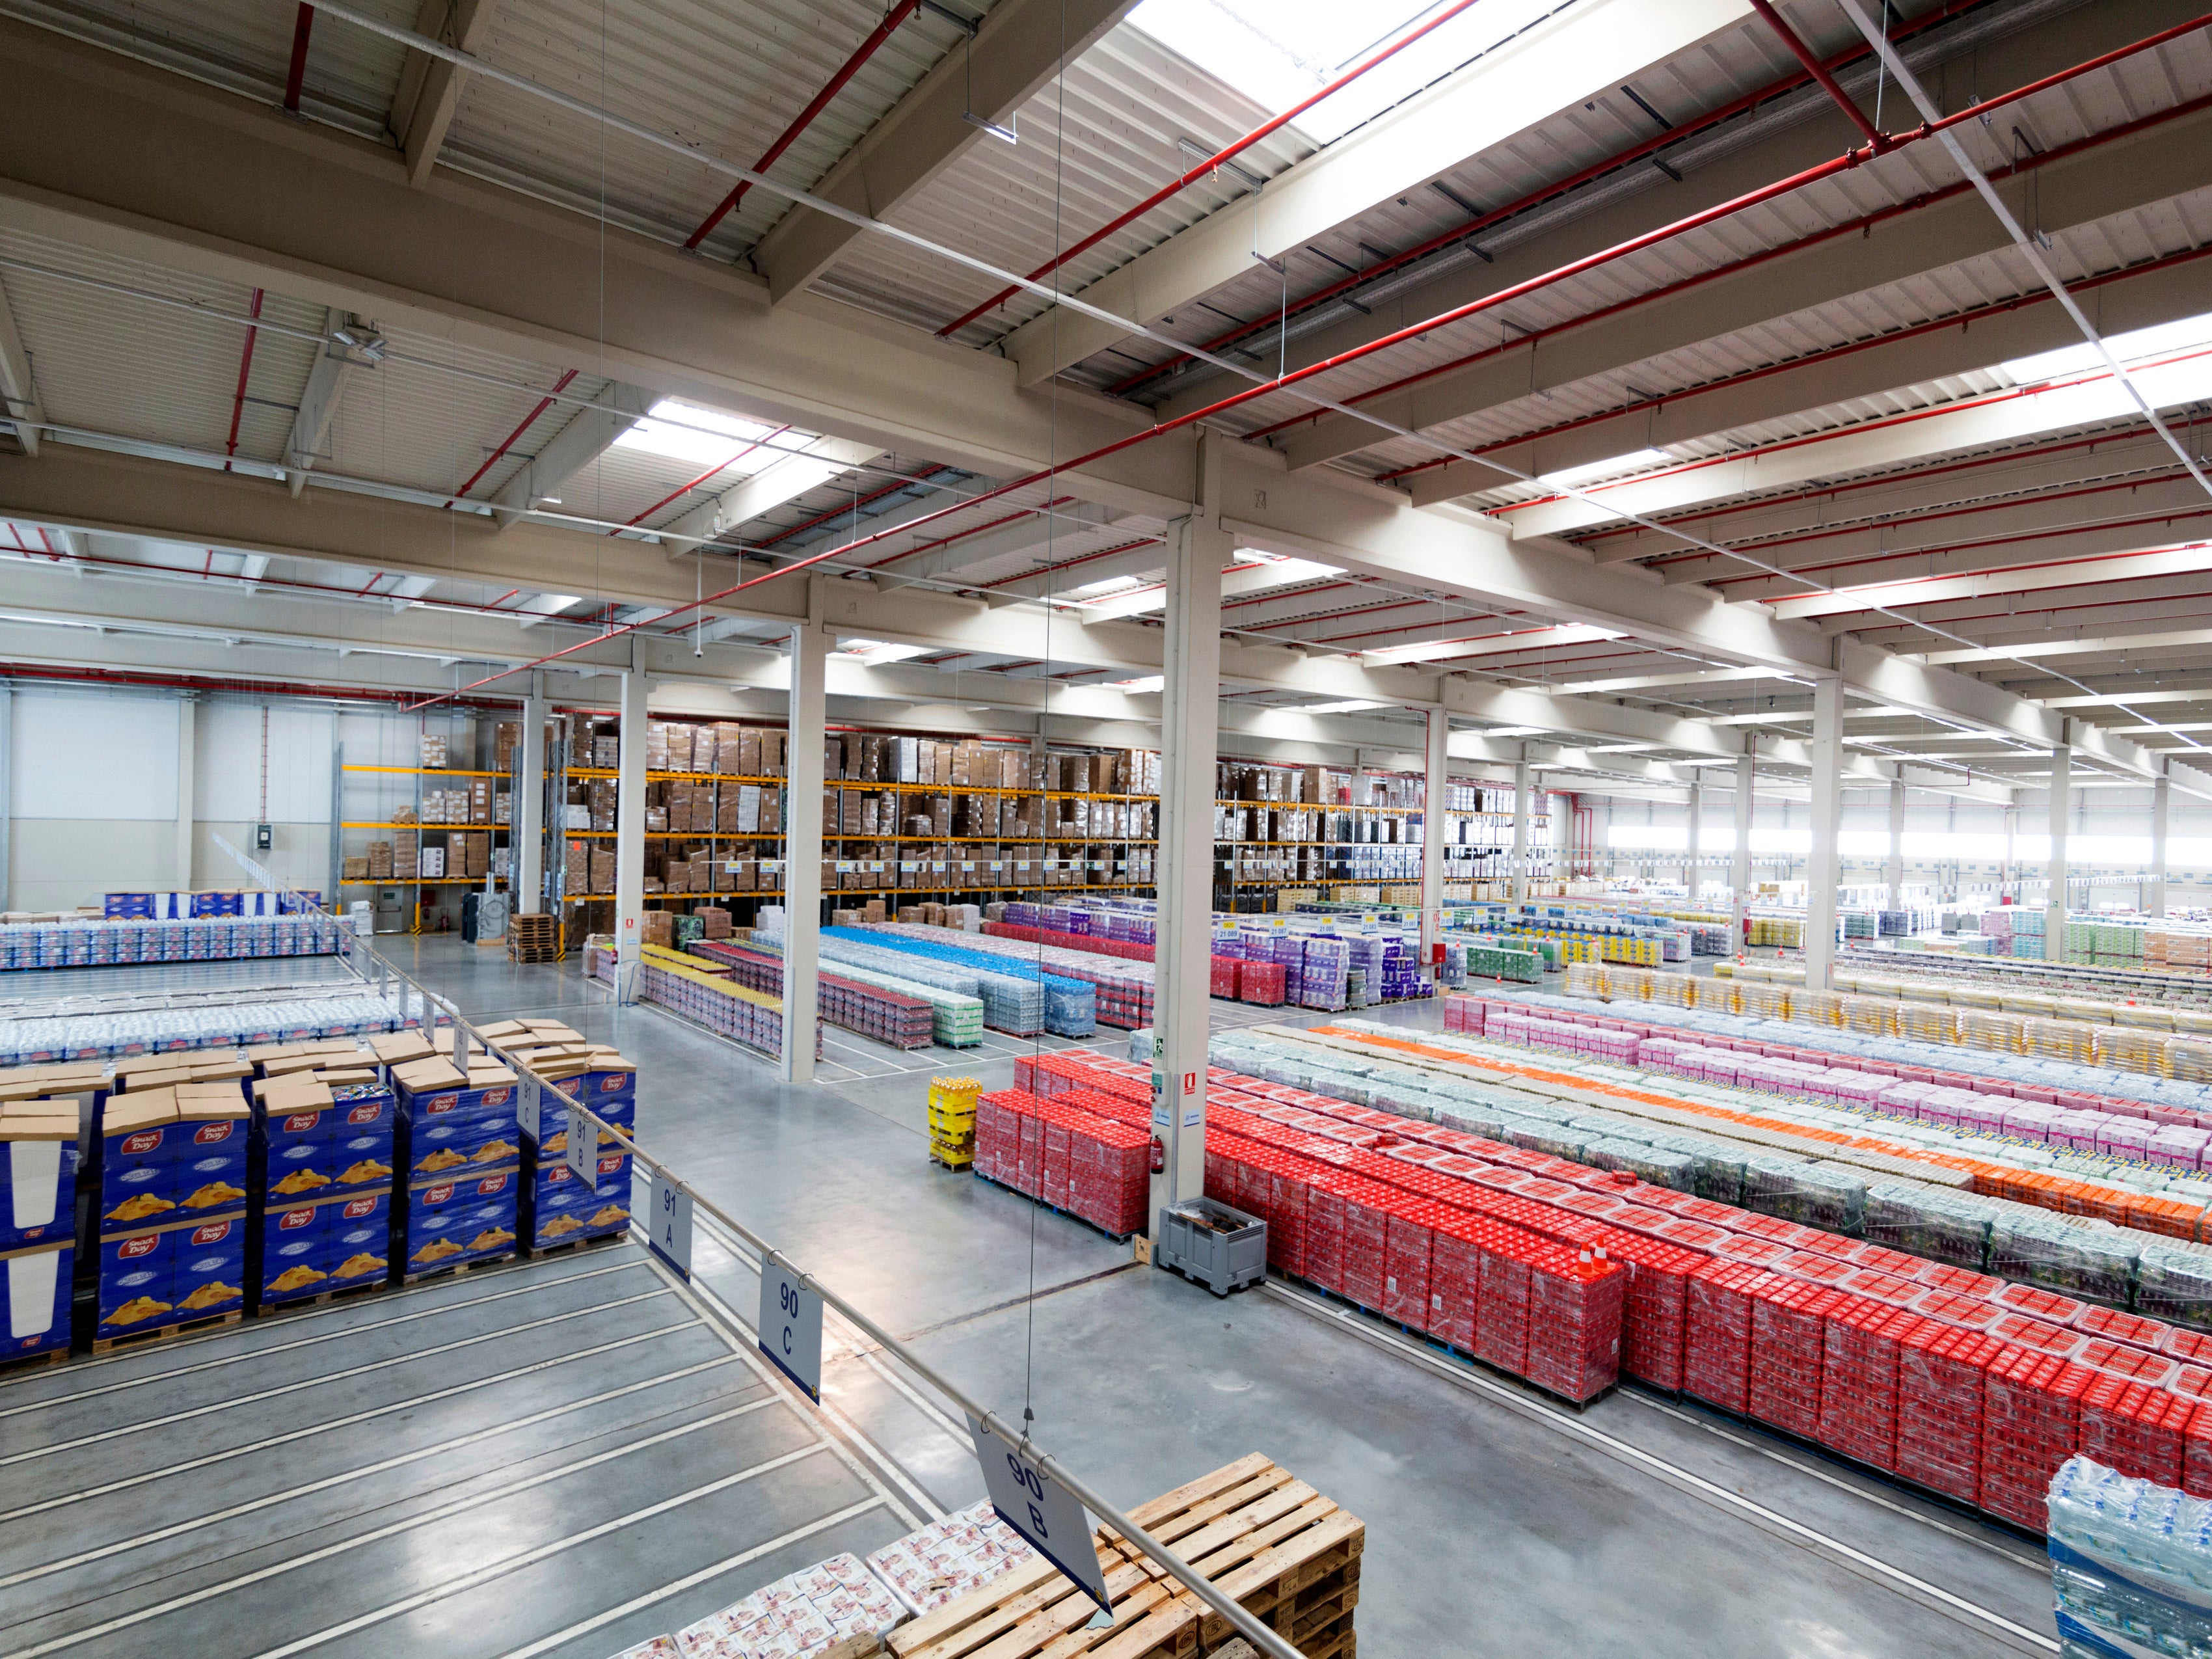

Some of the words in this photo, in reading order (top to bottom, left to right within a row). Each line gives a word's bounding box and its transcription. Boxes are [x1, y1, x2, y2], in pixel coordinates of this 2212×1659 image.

[524, 1083, 531, 1101] 91
[525, 1107, 530, 1123] C
[204, 1125, 228, 1133] Snack
[206, 1131, 224, 1140] Day
[578, 1120, 585, 1142] 91
[131, 1135, 157, 1144] Snack
[133, 1142, 153, 1150] Day
[578, 1148, 583, 1167] B
[665, 1189, 675, 1217] 91
[289, 1210, 311, 1219] Snack
[289, 1217, 306, 1225] Day
[202, 1224, 226, 1234] Snack
[203, 1230, 221, 1240] Day
[666, 1224, 672, 1248] A
[129, 1238, 154, 1248] Snack
[129, 1244, 150, 1254] Day
[781, 1282, 798, 1319] 90
[783, 1326, 792, 1355] C
[1007, 1453, 1044, 1502] 90
[1027, 1500, 1048, 1539] B
